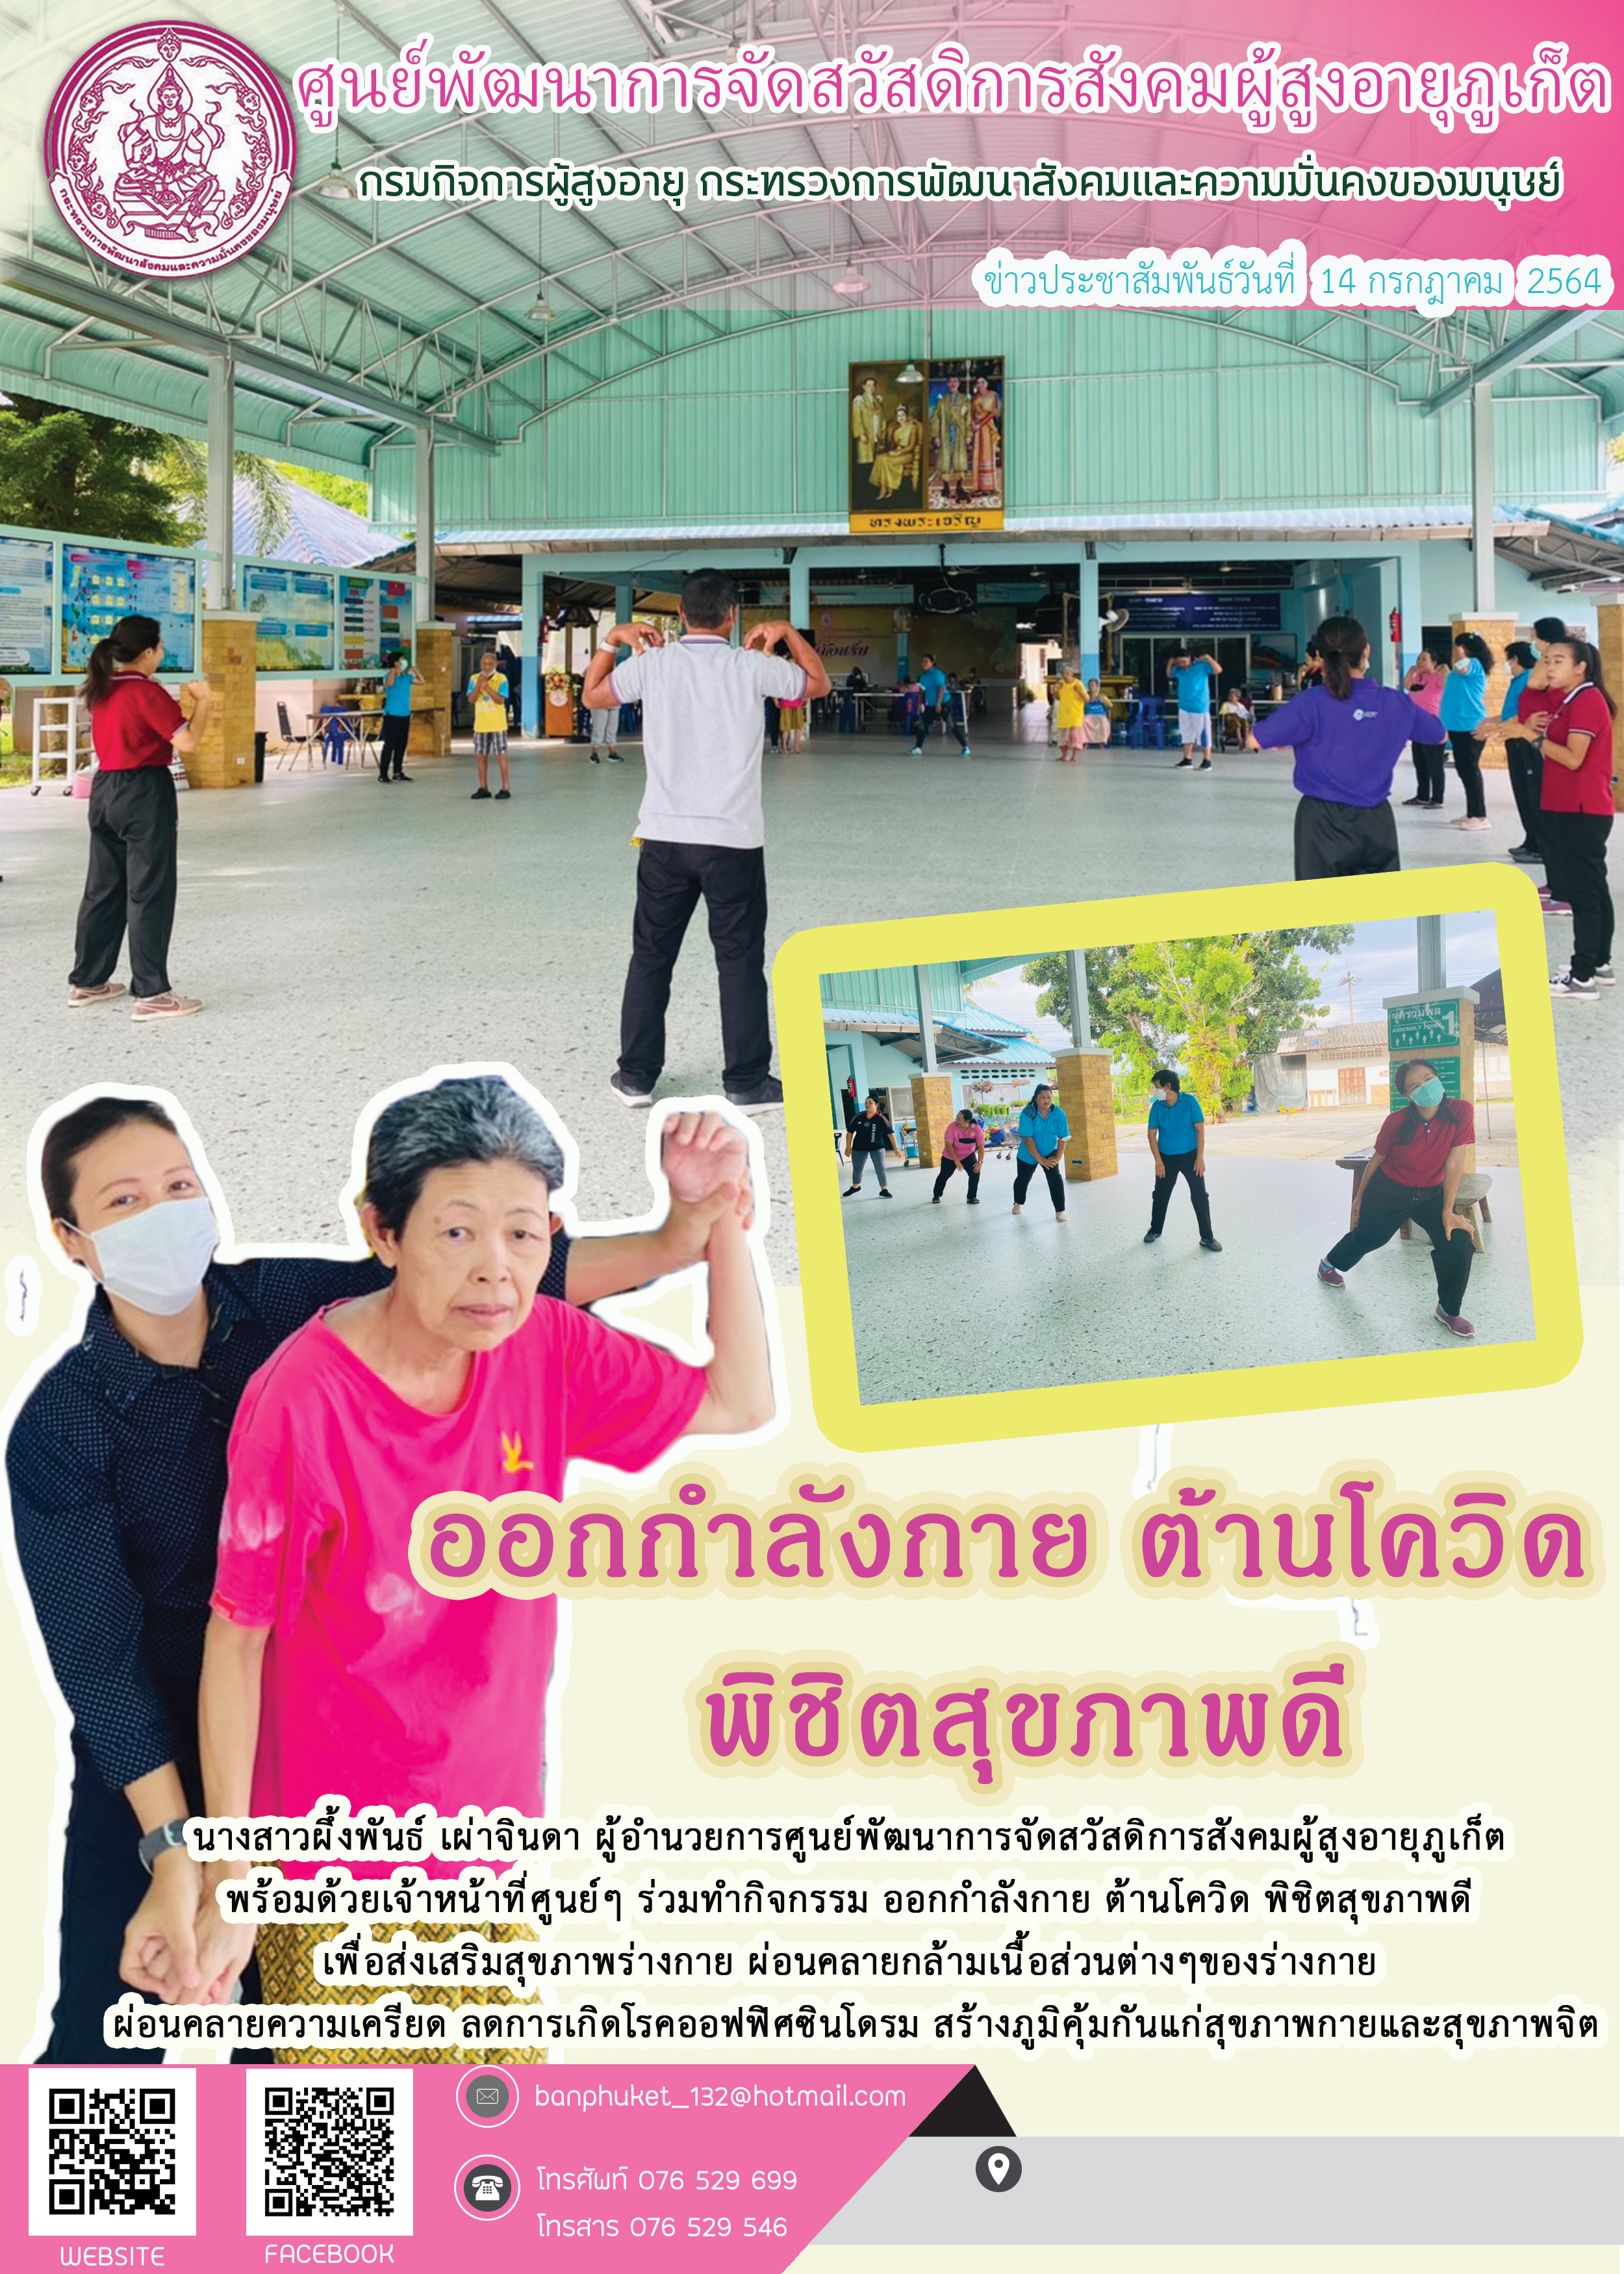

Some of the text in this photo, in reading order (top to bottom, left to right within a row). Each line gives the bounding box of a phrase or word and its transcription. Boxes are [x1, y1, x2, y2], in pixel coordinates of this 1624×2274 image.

[869, 513, 981, 528] ทรงพระเจริญ
[1442, 1010, 1454, 1035] 1
